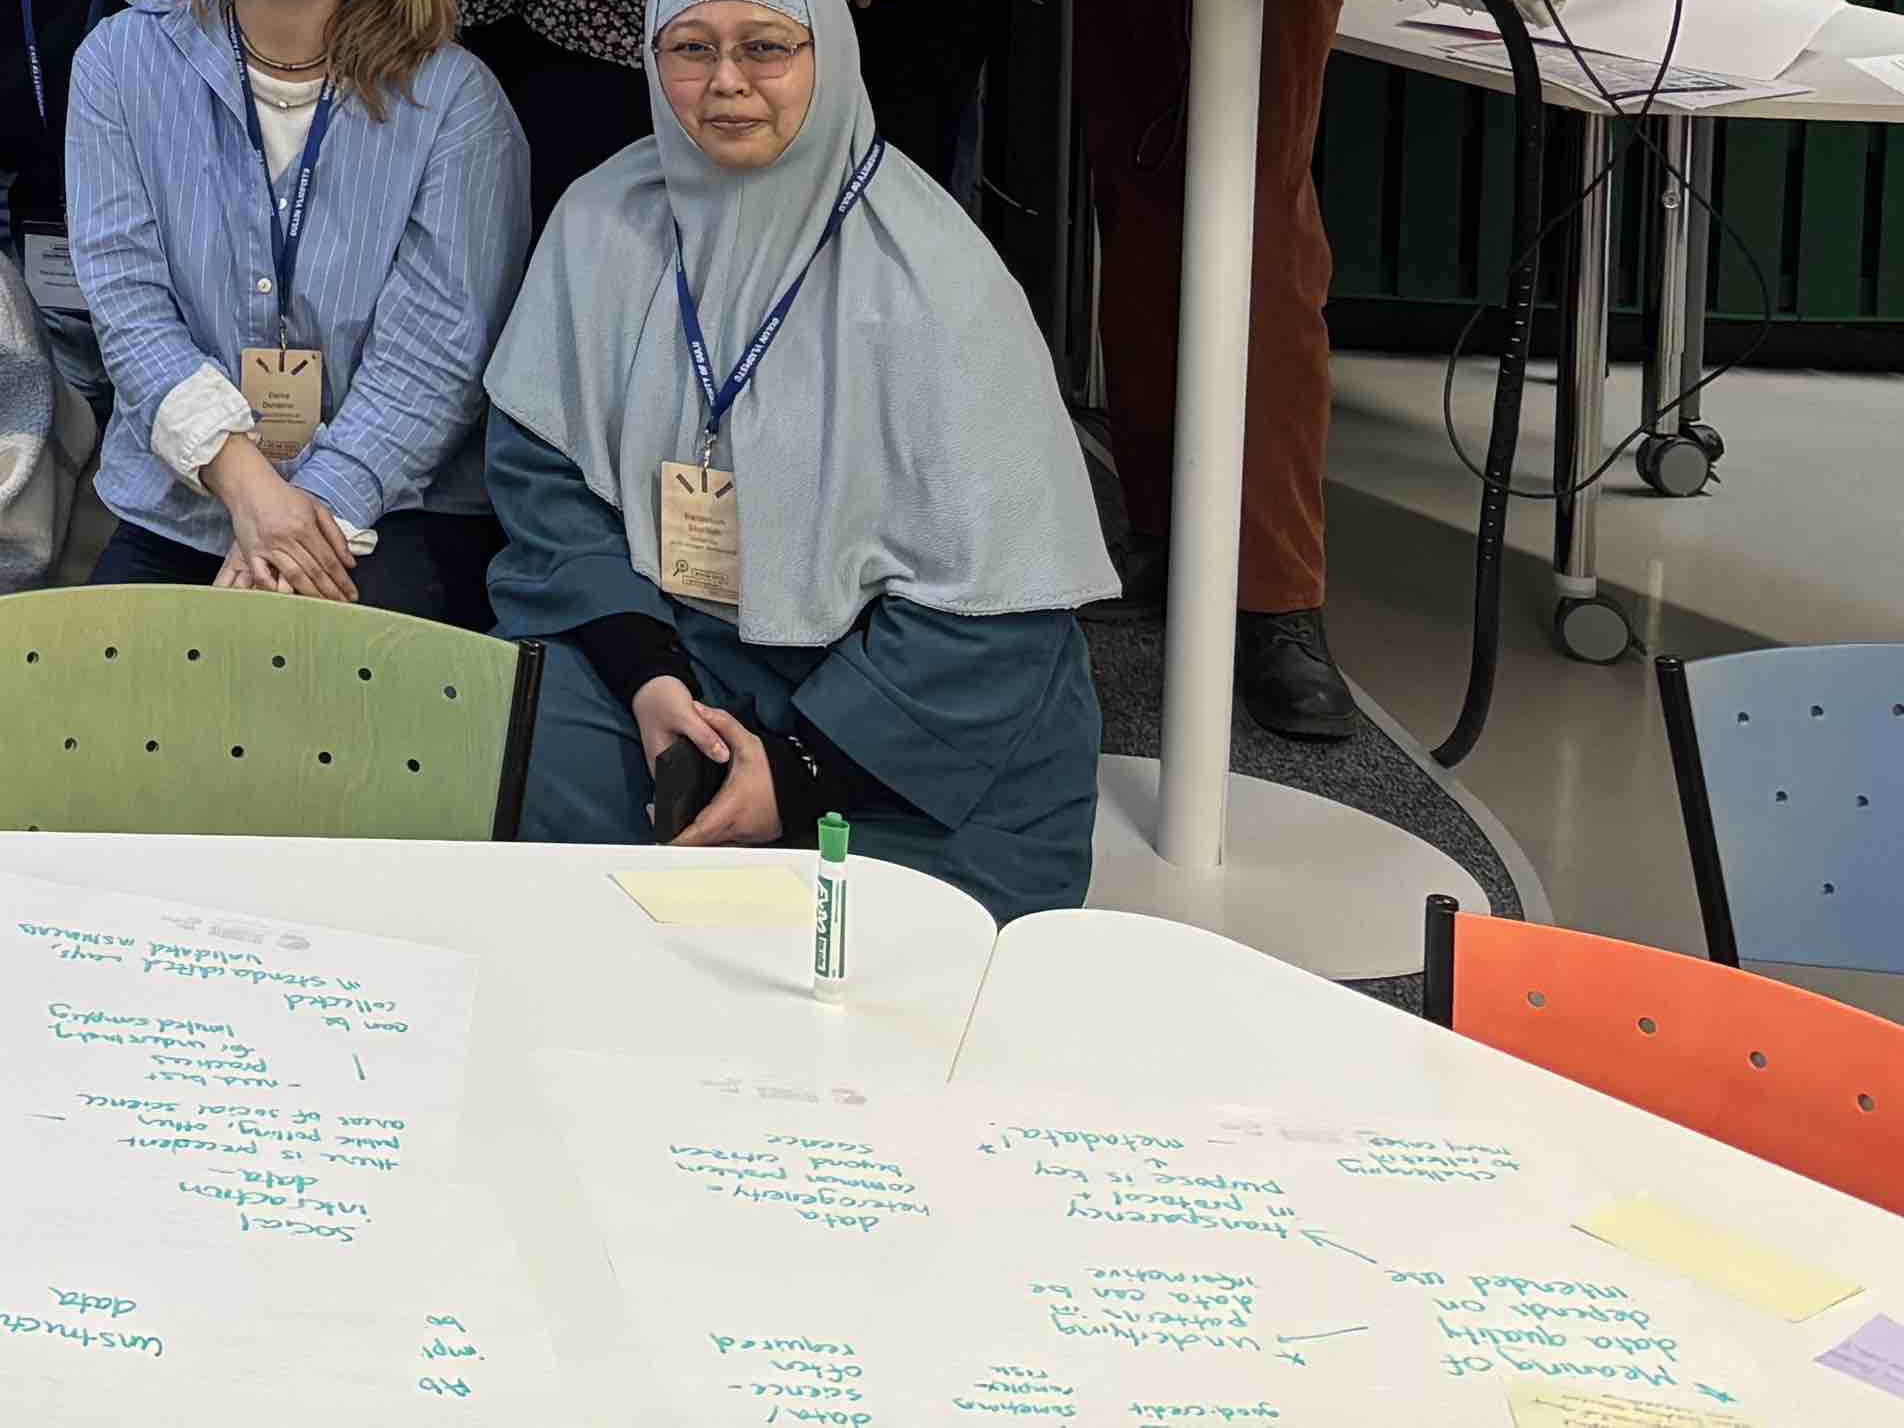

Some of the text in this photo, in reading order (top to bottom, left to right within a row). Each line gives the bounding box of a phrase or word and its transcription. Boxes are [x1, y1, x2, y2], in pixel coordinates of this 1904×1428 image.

[1108, 1172, 1133, 1183] is
[1066, 1196, 1288, 1240] transparency
[1113, 1191, 1295, 1217] in protocol
[797, 1209, 880, 1233] data
[1032, 1284, 1253, 1314] data can be
[1383, 1270, 1629, 1300] intended use
[48, 1287, 137, 1319] data
[1434, 1298, 1486, 1312] on
[709, 1333, 855, 1356] required
[1437, 1316, 1677, 1362] data quality
